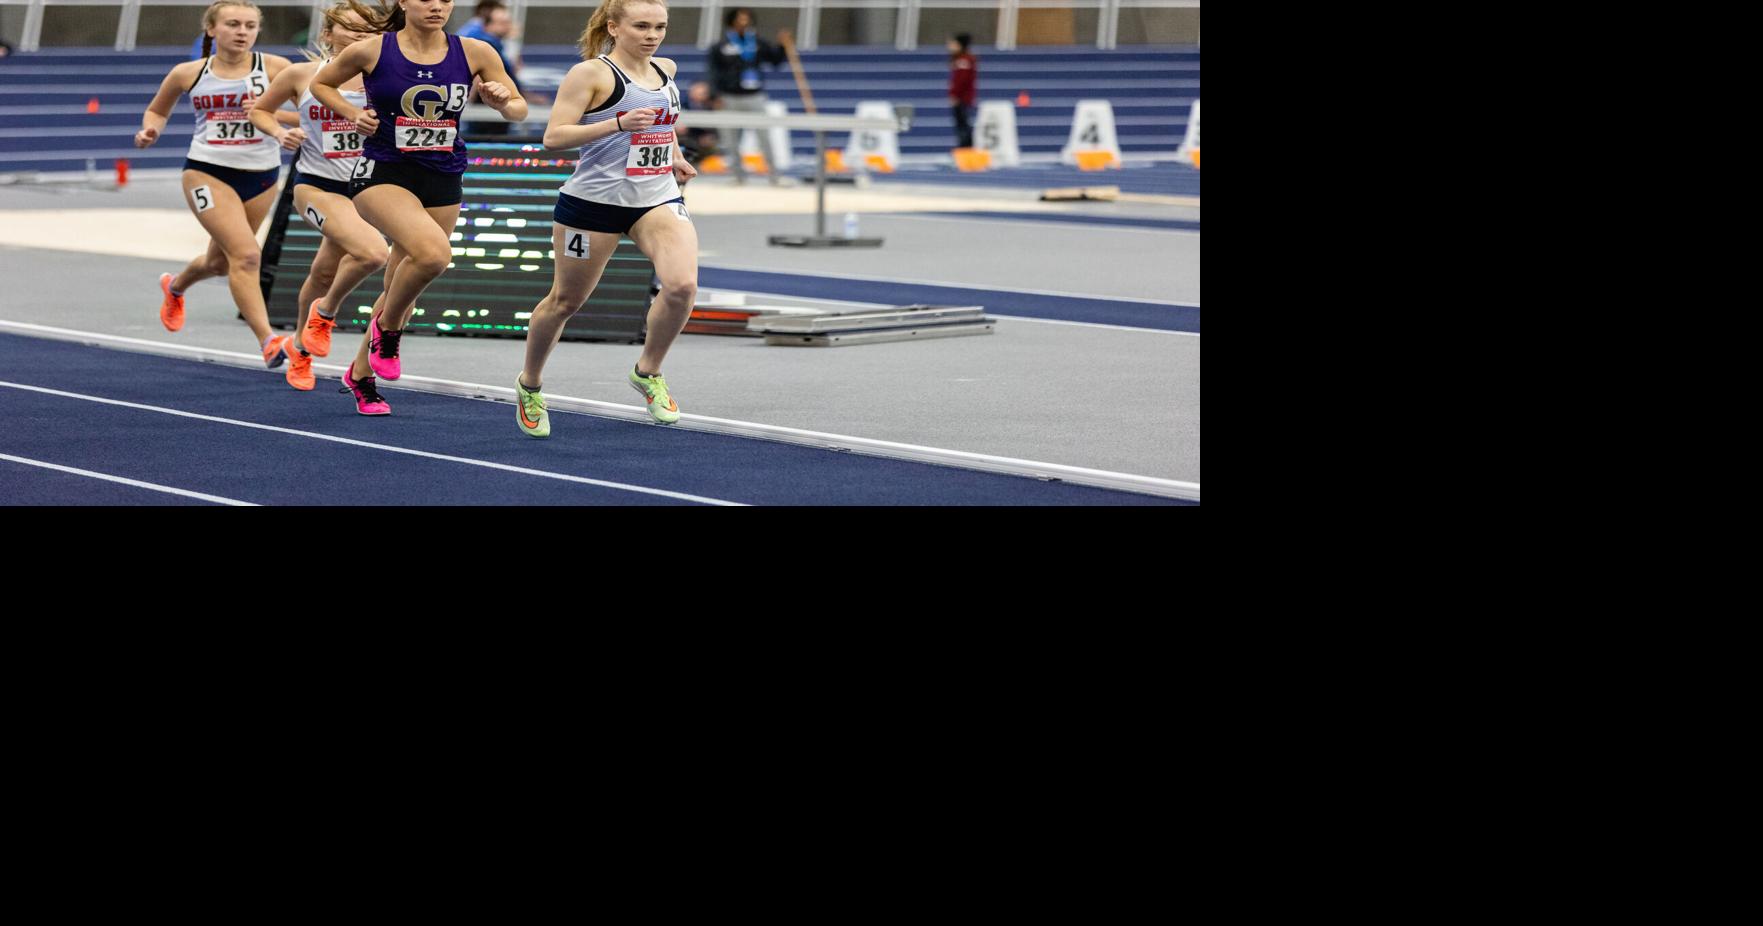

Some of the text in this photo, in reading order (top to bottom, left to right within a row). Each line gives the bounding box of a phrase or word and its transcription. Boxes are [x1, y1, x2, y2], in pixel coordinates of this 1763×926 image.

[251, 76, 265, 97] 5
[452, 86, 465, 110] 3
[668, 86, 680, 111] 4
[216, 122, 255, 138] 379
[405, 128, 448, 146] 224
[983, 121, 1001, 150] 5
[1080, 121, 1100, 143] 4
[333, 132, 360, 151] 38
[637, 146, 669, 167] 384
[355, 158, 369, 178] 3
[195, 188, 208, 209] 5
[307, 206, 324, 227] 2
[568, 233, 585, 258] 4
